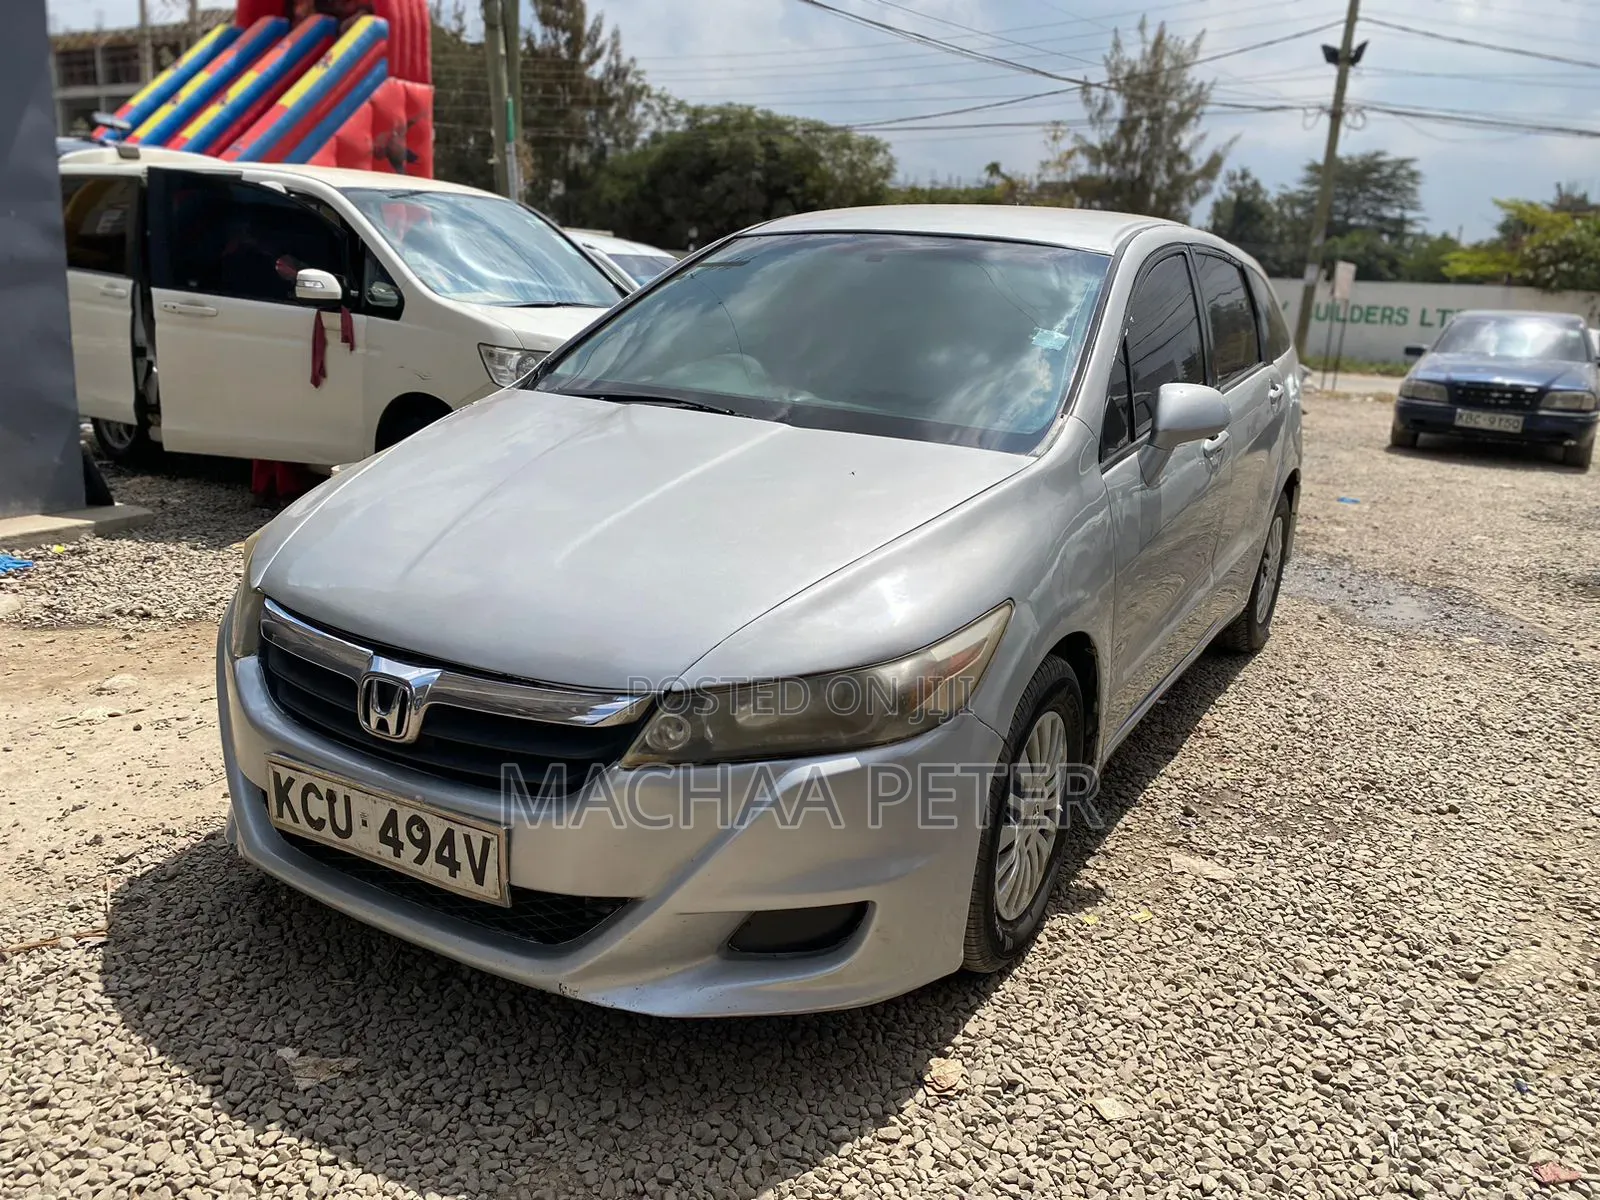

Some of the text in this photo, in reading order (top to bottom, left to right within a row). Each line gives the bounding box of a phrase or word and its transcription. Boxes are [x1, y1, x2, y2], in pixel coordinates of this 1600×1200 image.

[1311, 303, 1409, 326] UILDERS
[1420, 308, 1464, 329] LT
[272, 771, 491, 887] KCU 494V
